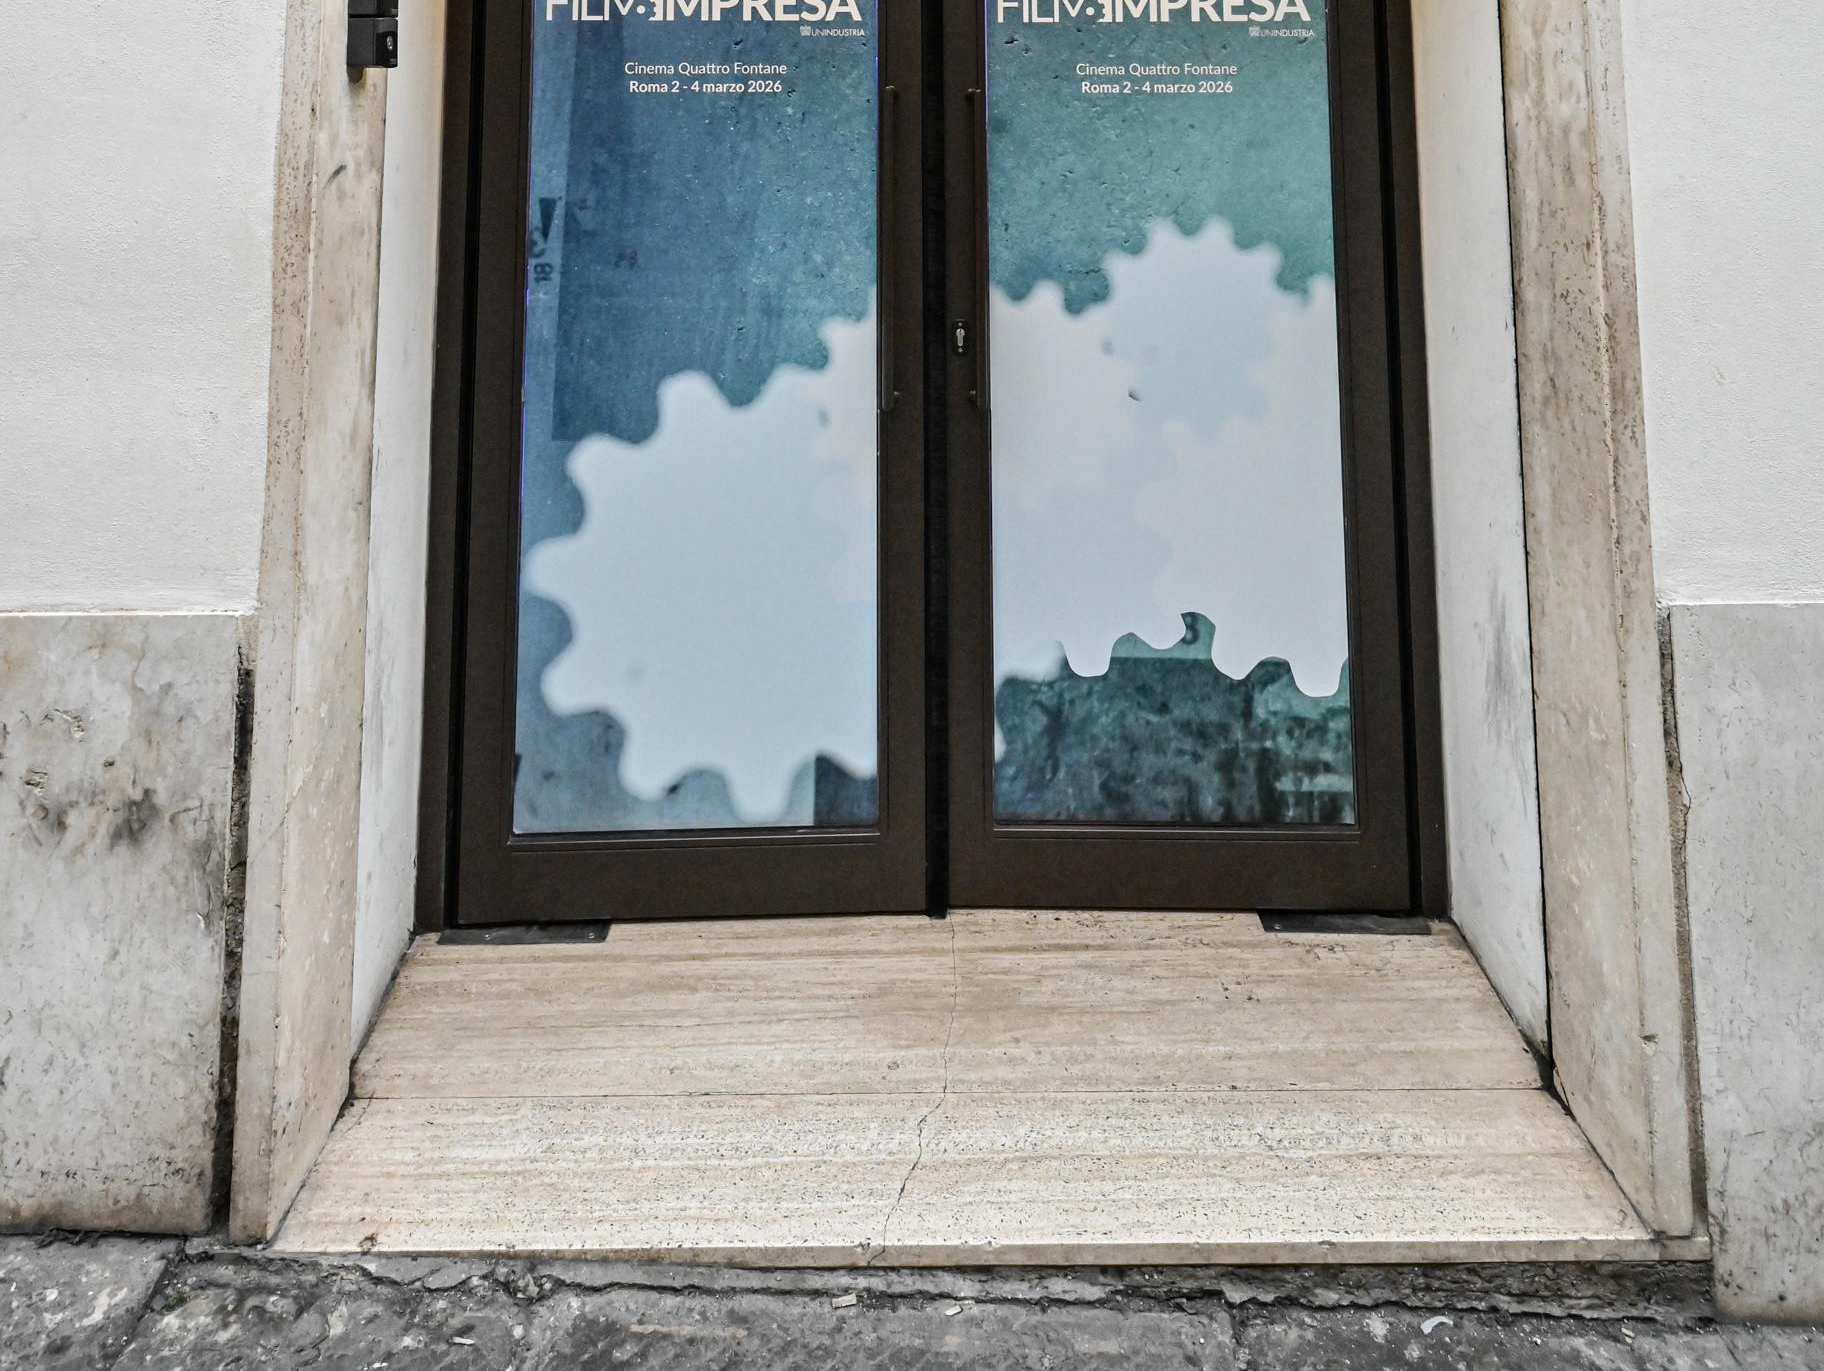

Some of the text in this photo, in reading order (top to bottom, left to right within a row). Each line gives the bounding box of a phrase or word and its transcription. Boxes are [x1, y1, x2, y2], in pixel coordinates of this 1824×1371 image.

[811, 27, 865, 37] UNINDUSTRIA
[1260, 27, 1315, 37] UNINDUSTRIA
[624, 62, 787, 76] Cinema Quattro Fontane
[1076, 63, 1238, 77] Cinema Quattro Fontane
[629, 81, 668, 93] Roma
[671, 81, 680, 93] 2
[691, 81, 700, 93] 4
[703, 83, 745, 93] marzo
[748, 81, 782, 93] 2026
[1081, 81, 1120, 94] Roma
[1123, 81, 1132, 93] 2
[1142, 81, 1151, 93] 4
[1154, 83, 1195, 93] marzo
[1199, 81, 1233, 93] 2026
